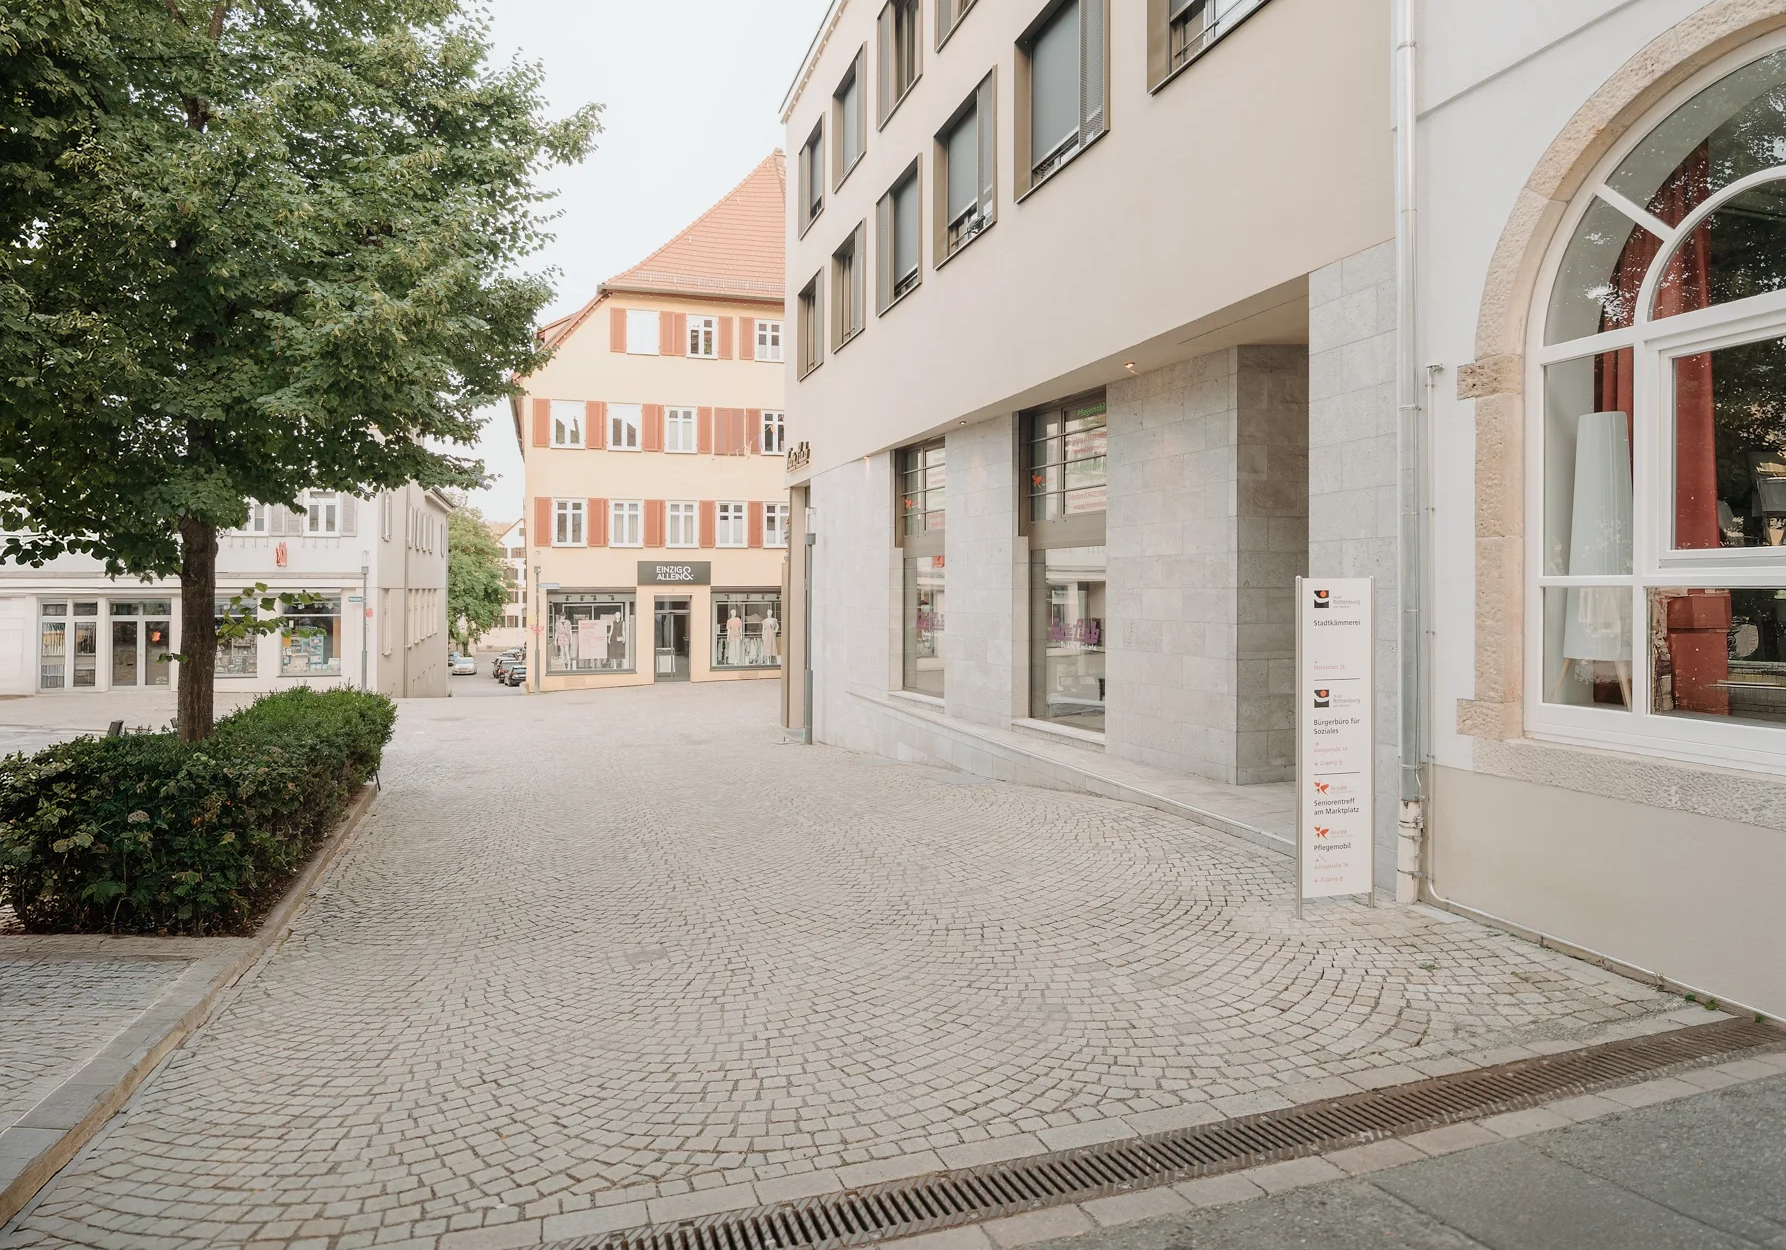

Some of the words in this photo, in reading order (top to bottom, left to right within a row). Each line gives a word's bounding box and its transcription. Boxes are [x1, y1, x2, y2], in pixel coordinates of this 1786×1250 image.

[656, 565, 682, 573] EINZIG
[1313, 718, 1349, 726] Bürgerbüro
[1313, 798, 1355, 807] Seniorentreff
[1325, 807, 1359, 815] Marktplatz
[1313, 842, 1351, 852] Pflegemobil
